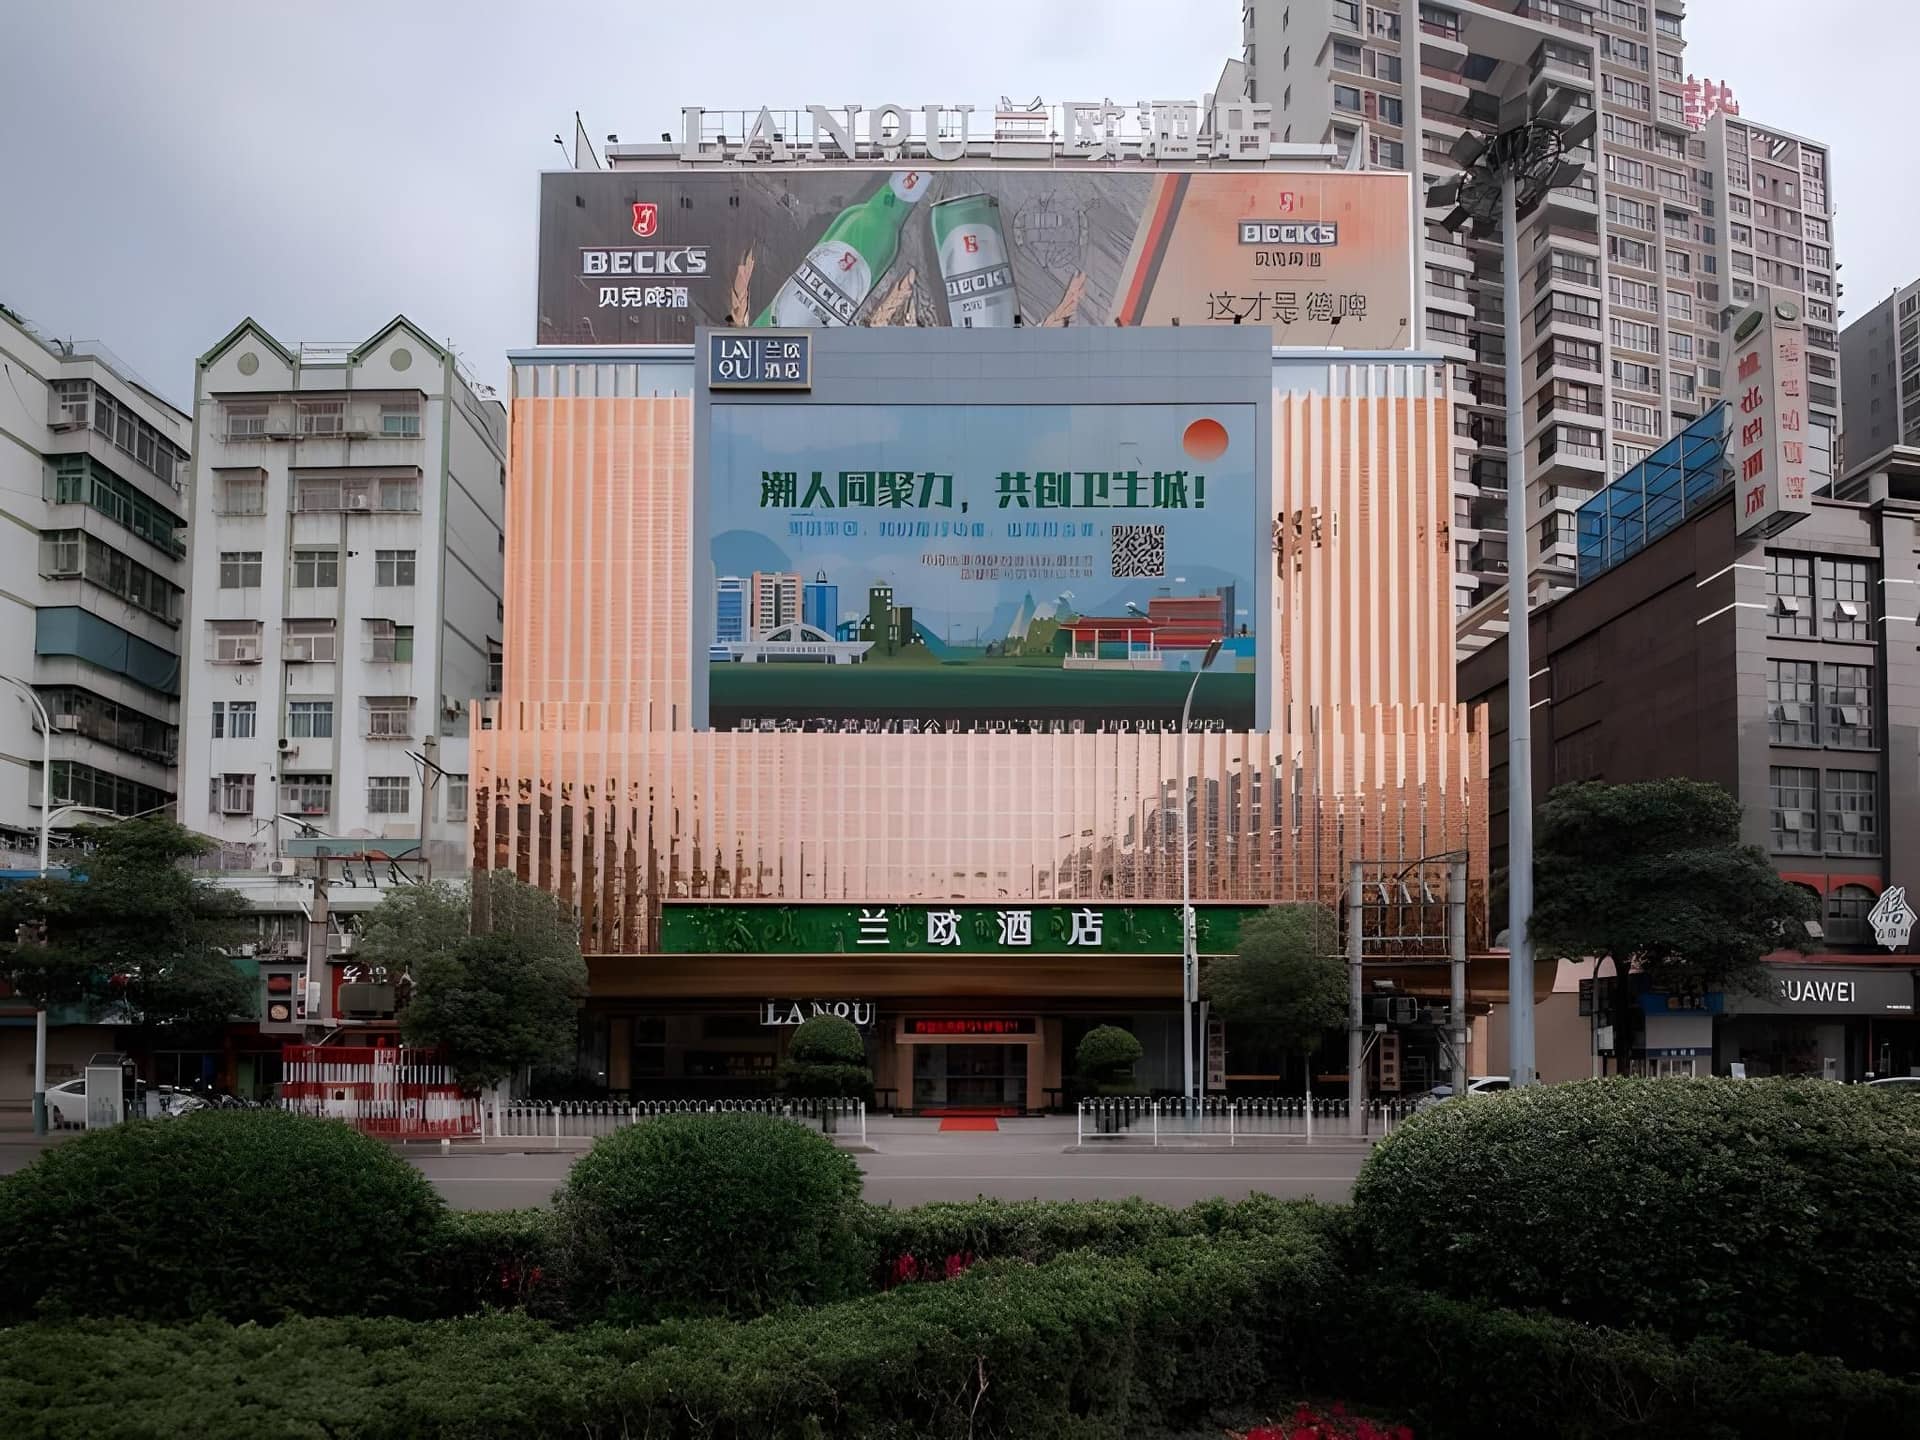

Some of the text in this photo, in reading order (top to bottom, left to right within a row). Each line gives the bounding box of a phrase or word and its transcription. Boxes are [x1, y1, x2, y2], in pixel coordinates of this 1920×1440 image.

[583, 246, 707, 274] BECK'S
[856, 907, 1104, 946] 兰欧酒店
